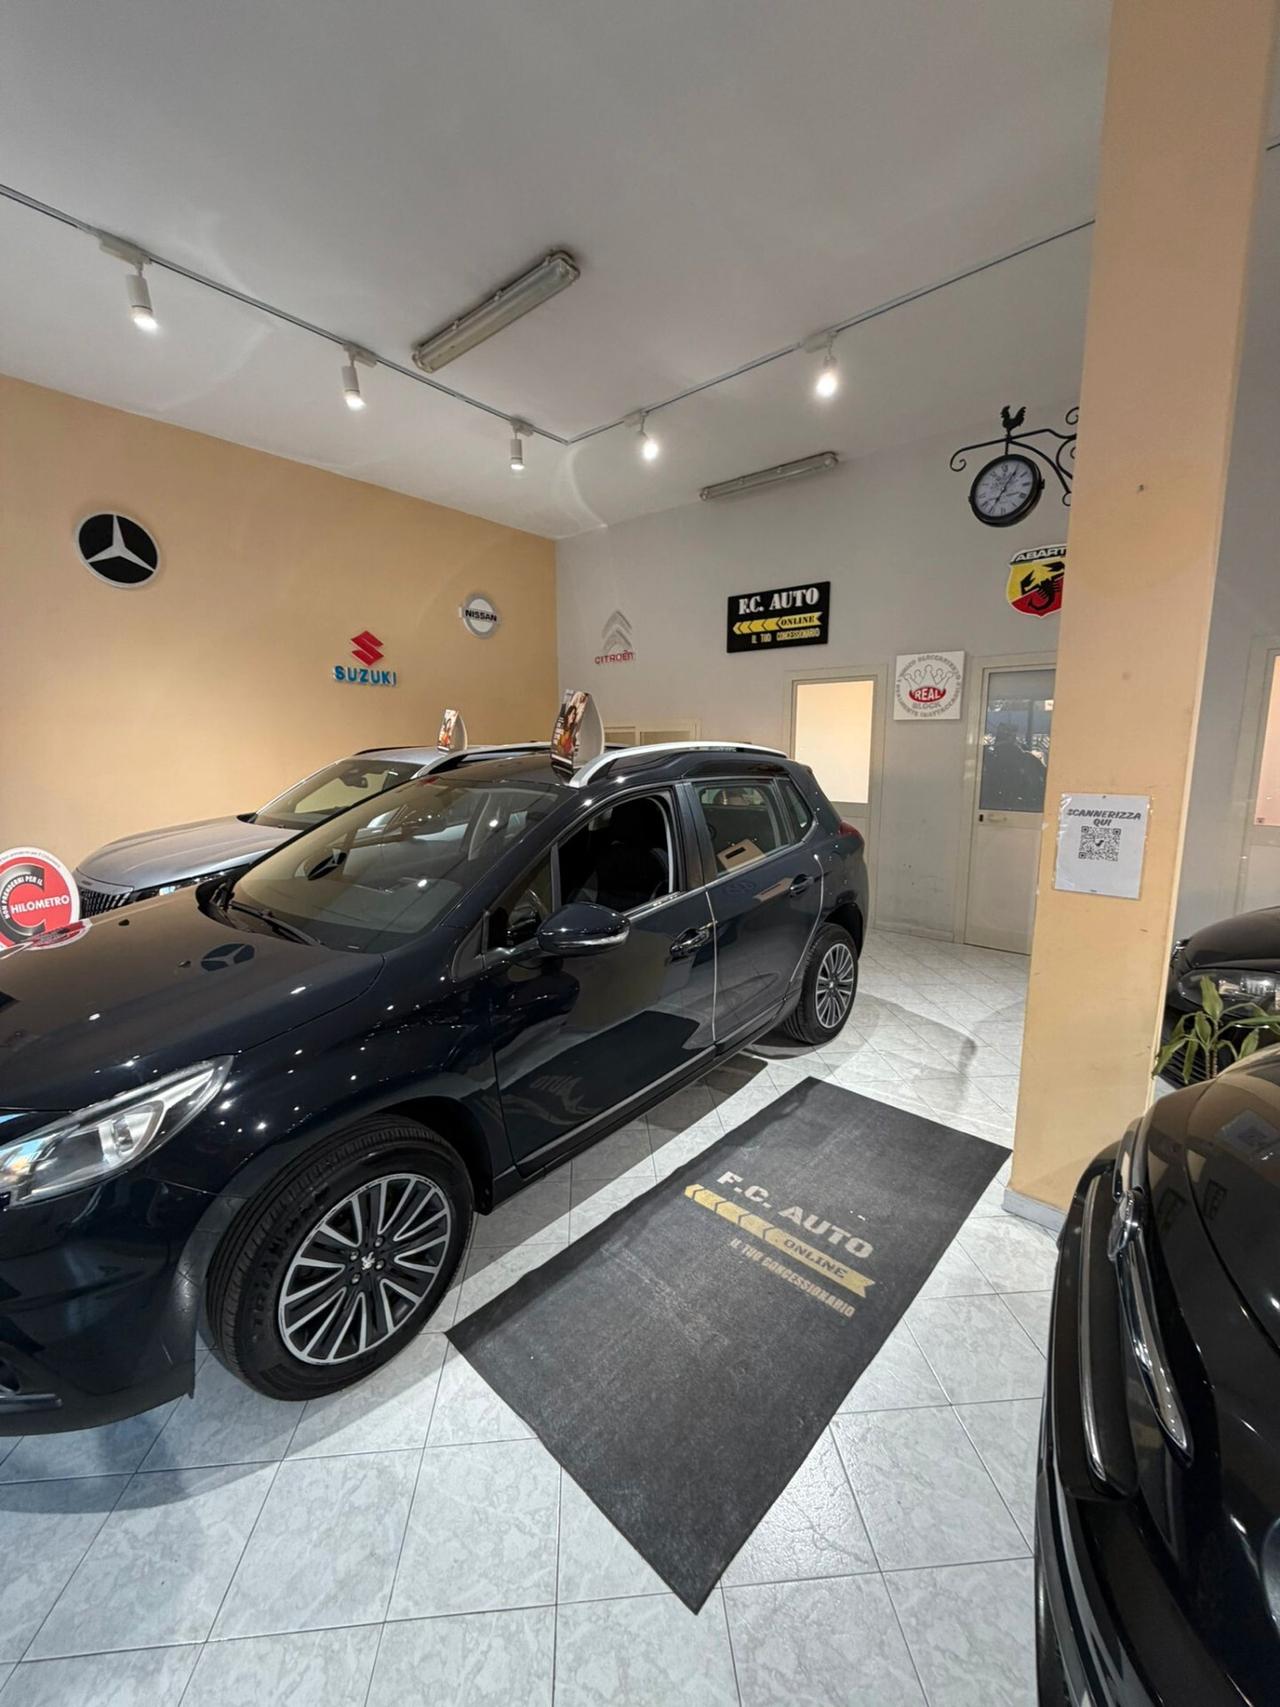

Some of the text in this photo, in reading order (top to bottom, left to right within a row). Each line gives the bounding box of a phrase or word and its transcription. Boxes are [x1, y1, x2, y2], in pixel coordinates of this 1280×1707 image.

[1016, 548, 1066, 561] ABART
[769, 587, 819, 610] AUTO
[465, 609, 497, 622] NISSAN
[780, 615, 815, 626] ONLINE
[334, 665, 397, 686] SUZUKI
[914, 688, 941, 701] REAL
[1067, 808, 1141, 820] SCANNERIZZA
[1093, 818, 1112, 827] QUI
[716, 1171, 874, 1258] F.C. AUTO
[784, 1239, 849, 1279] ONLINE
